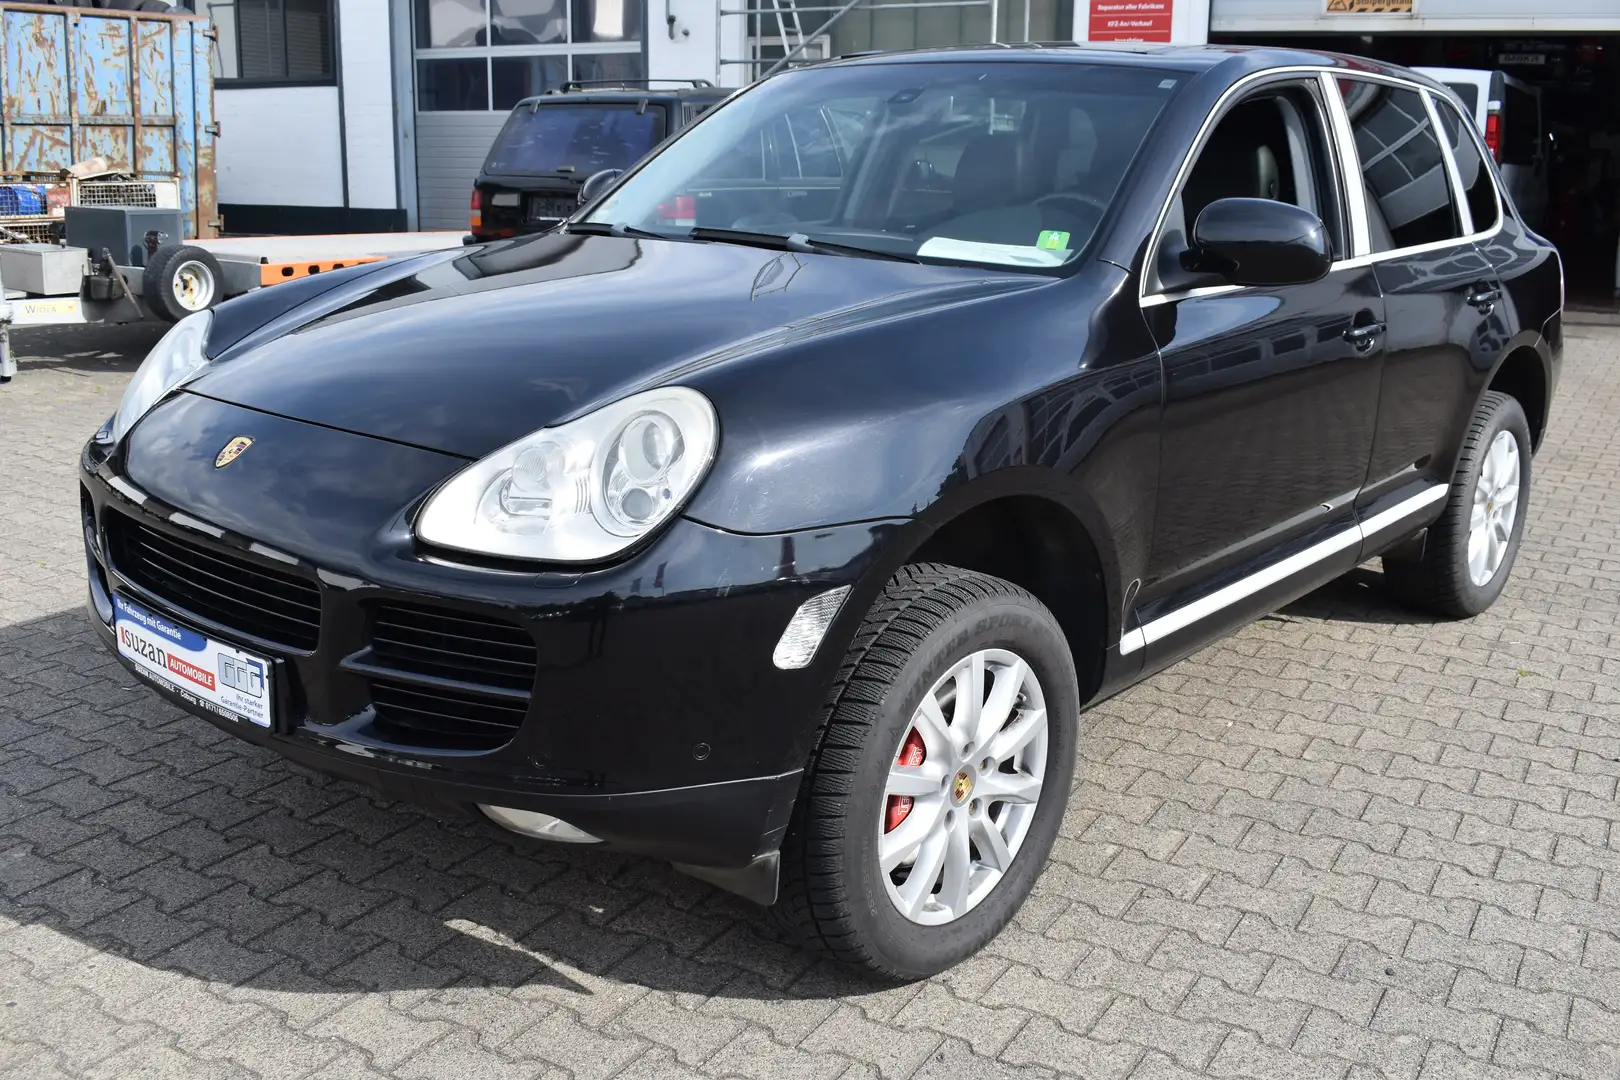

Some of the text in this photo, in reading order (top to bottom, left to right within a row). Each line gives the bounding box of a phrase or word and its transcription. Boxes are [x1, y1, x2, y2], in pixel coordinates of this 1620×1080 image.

[124, 602, 147, 625] Fahrzeug
[146, 617, 157, 629] mit
[156, 620, 182, 641] Garantie
[169, 656, 213, 687] AUTOMOBILE
